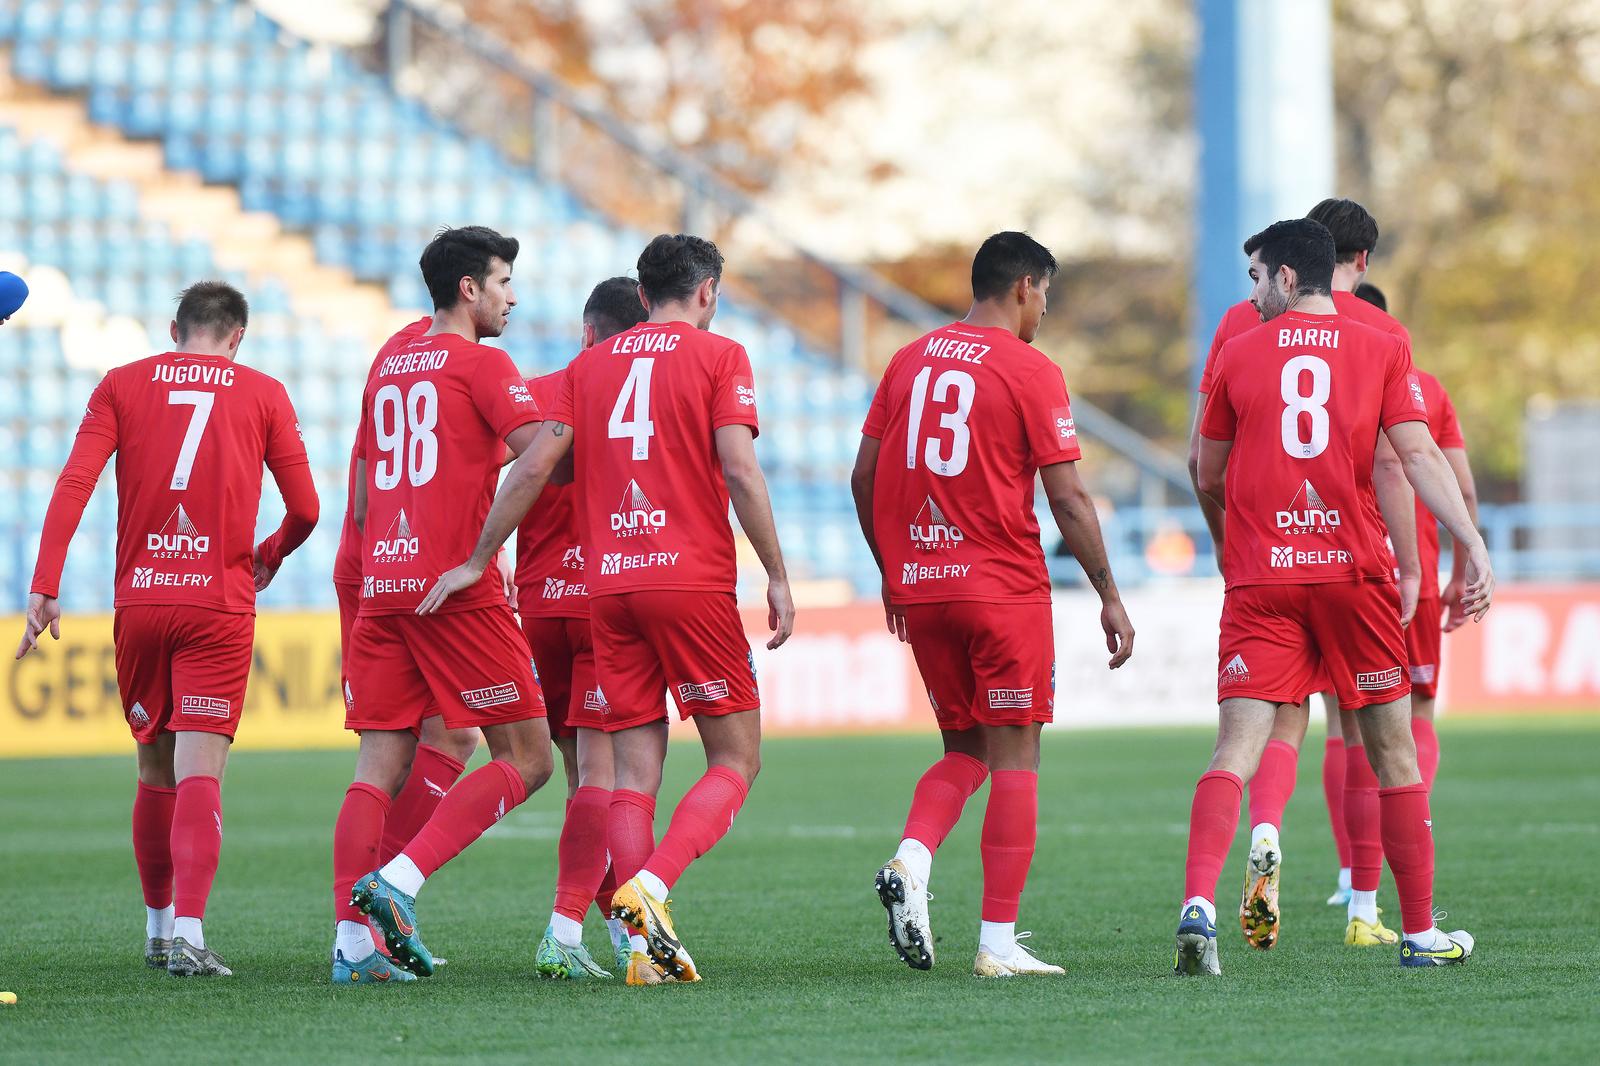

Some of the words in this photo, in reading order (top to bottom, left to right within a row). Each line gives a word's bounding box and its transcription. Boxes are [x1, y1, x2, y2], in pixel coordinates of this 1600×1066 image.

[612, 333, 681, 354] LEOVAC
[1278, 328, 1340, 349] BARRI
[923, 337, 992, 365] MIEREZ
[379, 350, 449, 377] CHEBERKO
[152, 364, 235, 387] JUGOVIĆ
[608, 357, 655, 461] 4
[1280, 355, 1331, 459] 8
[906, 366, 976, 477] 13
[168, 390, 216, 491] 7
[374, 380, 438, 491] 98
[616, 527, 660, 538] ASZFALT
[1285, 527, 1337, 536] ASZFALT
[152, 551, 202, 560] ASZFALT
[374, 555, 415, 564] ASZFALT
[622, 552, 680, 570] BELFRY
[153, 572, 213, 588] BELFRY
[918, 564, 971, 580] BELFRY
[376, 578, 427, 593] BELFRY
